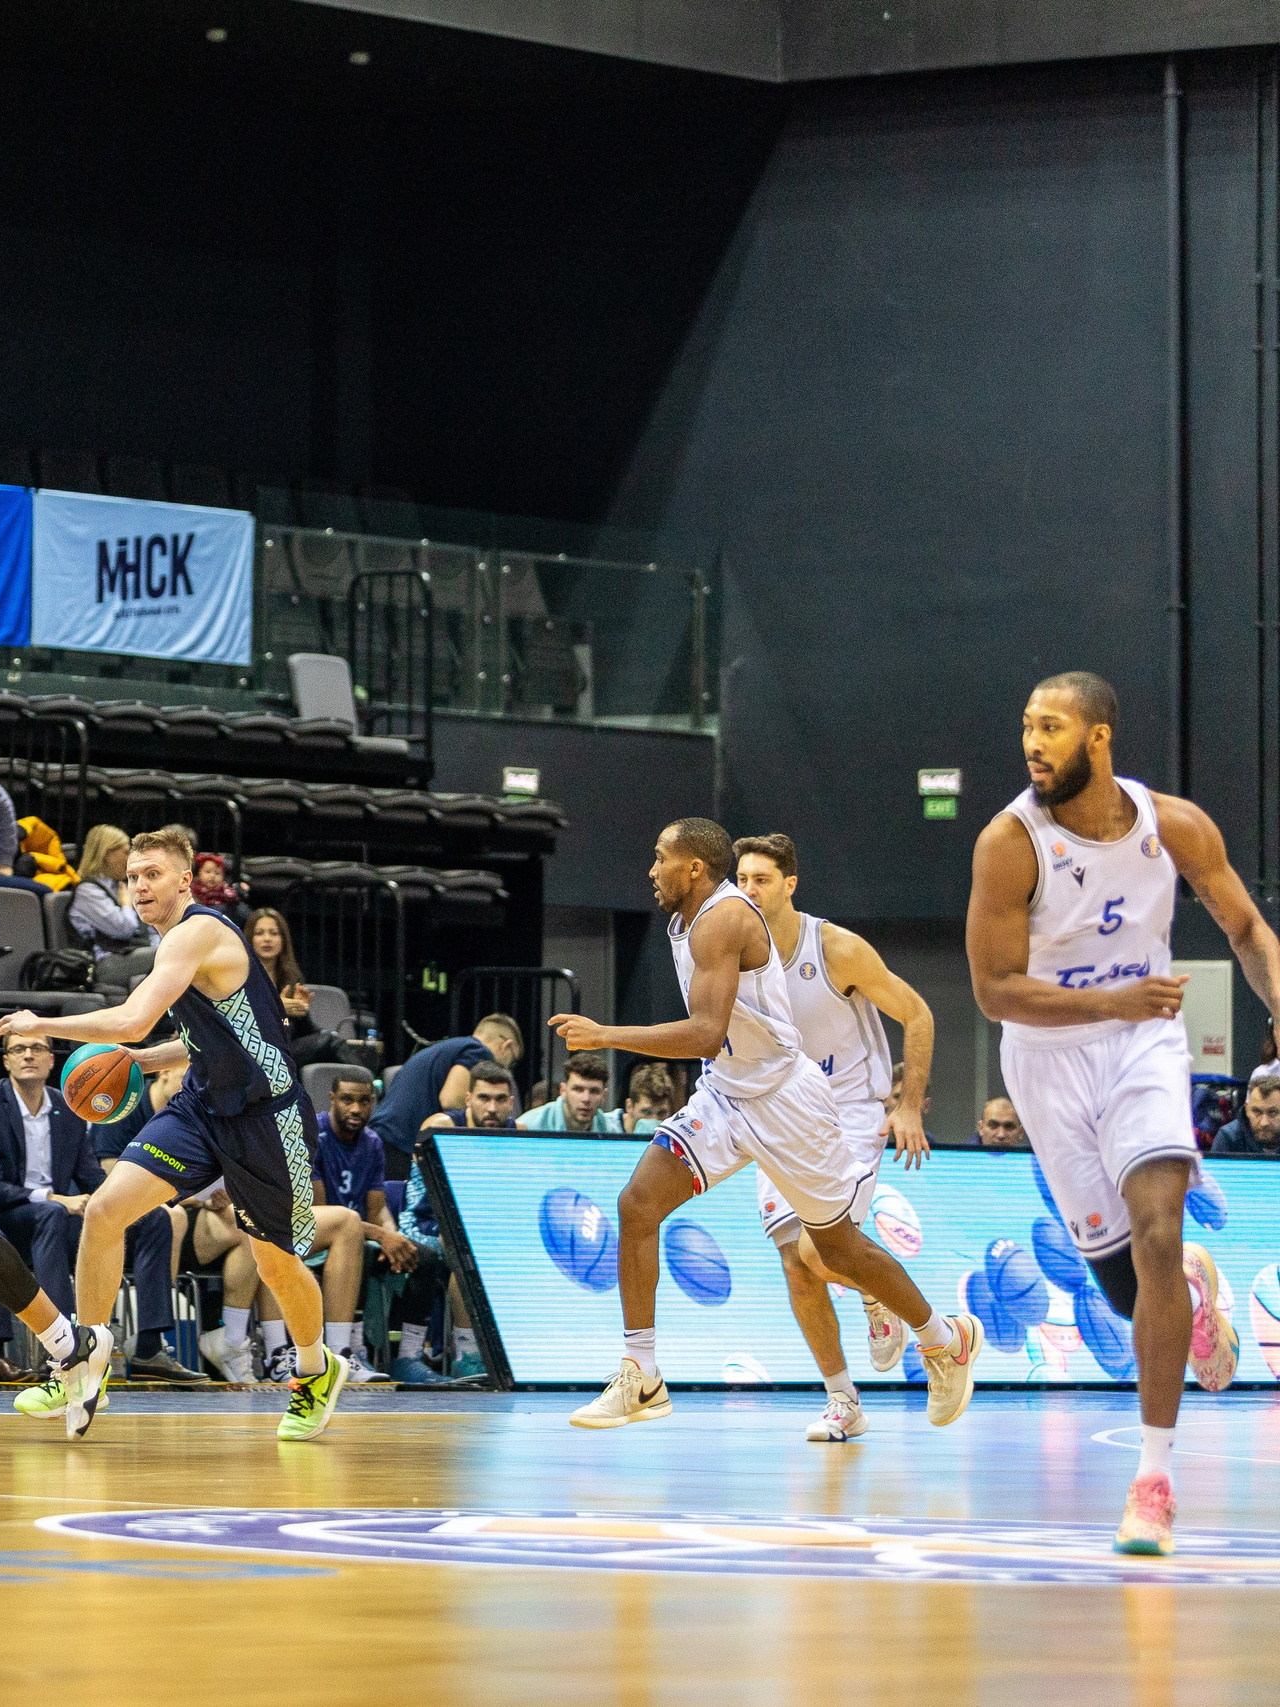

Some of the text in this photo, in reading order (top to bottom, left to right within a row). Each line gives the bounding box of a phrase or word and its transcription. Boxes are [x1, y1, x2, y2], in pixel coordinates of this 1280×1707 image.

[1098, 896, 1124, 935] 5
[142, 1143, 187, 1173] евроопт
[338, 1169, 352, 1194] 3
